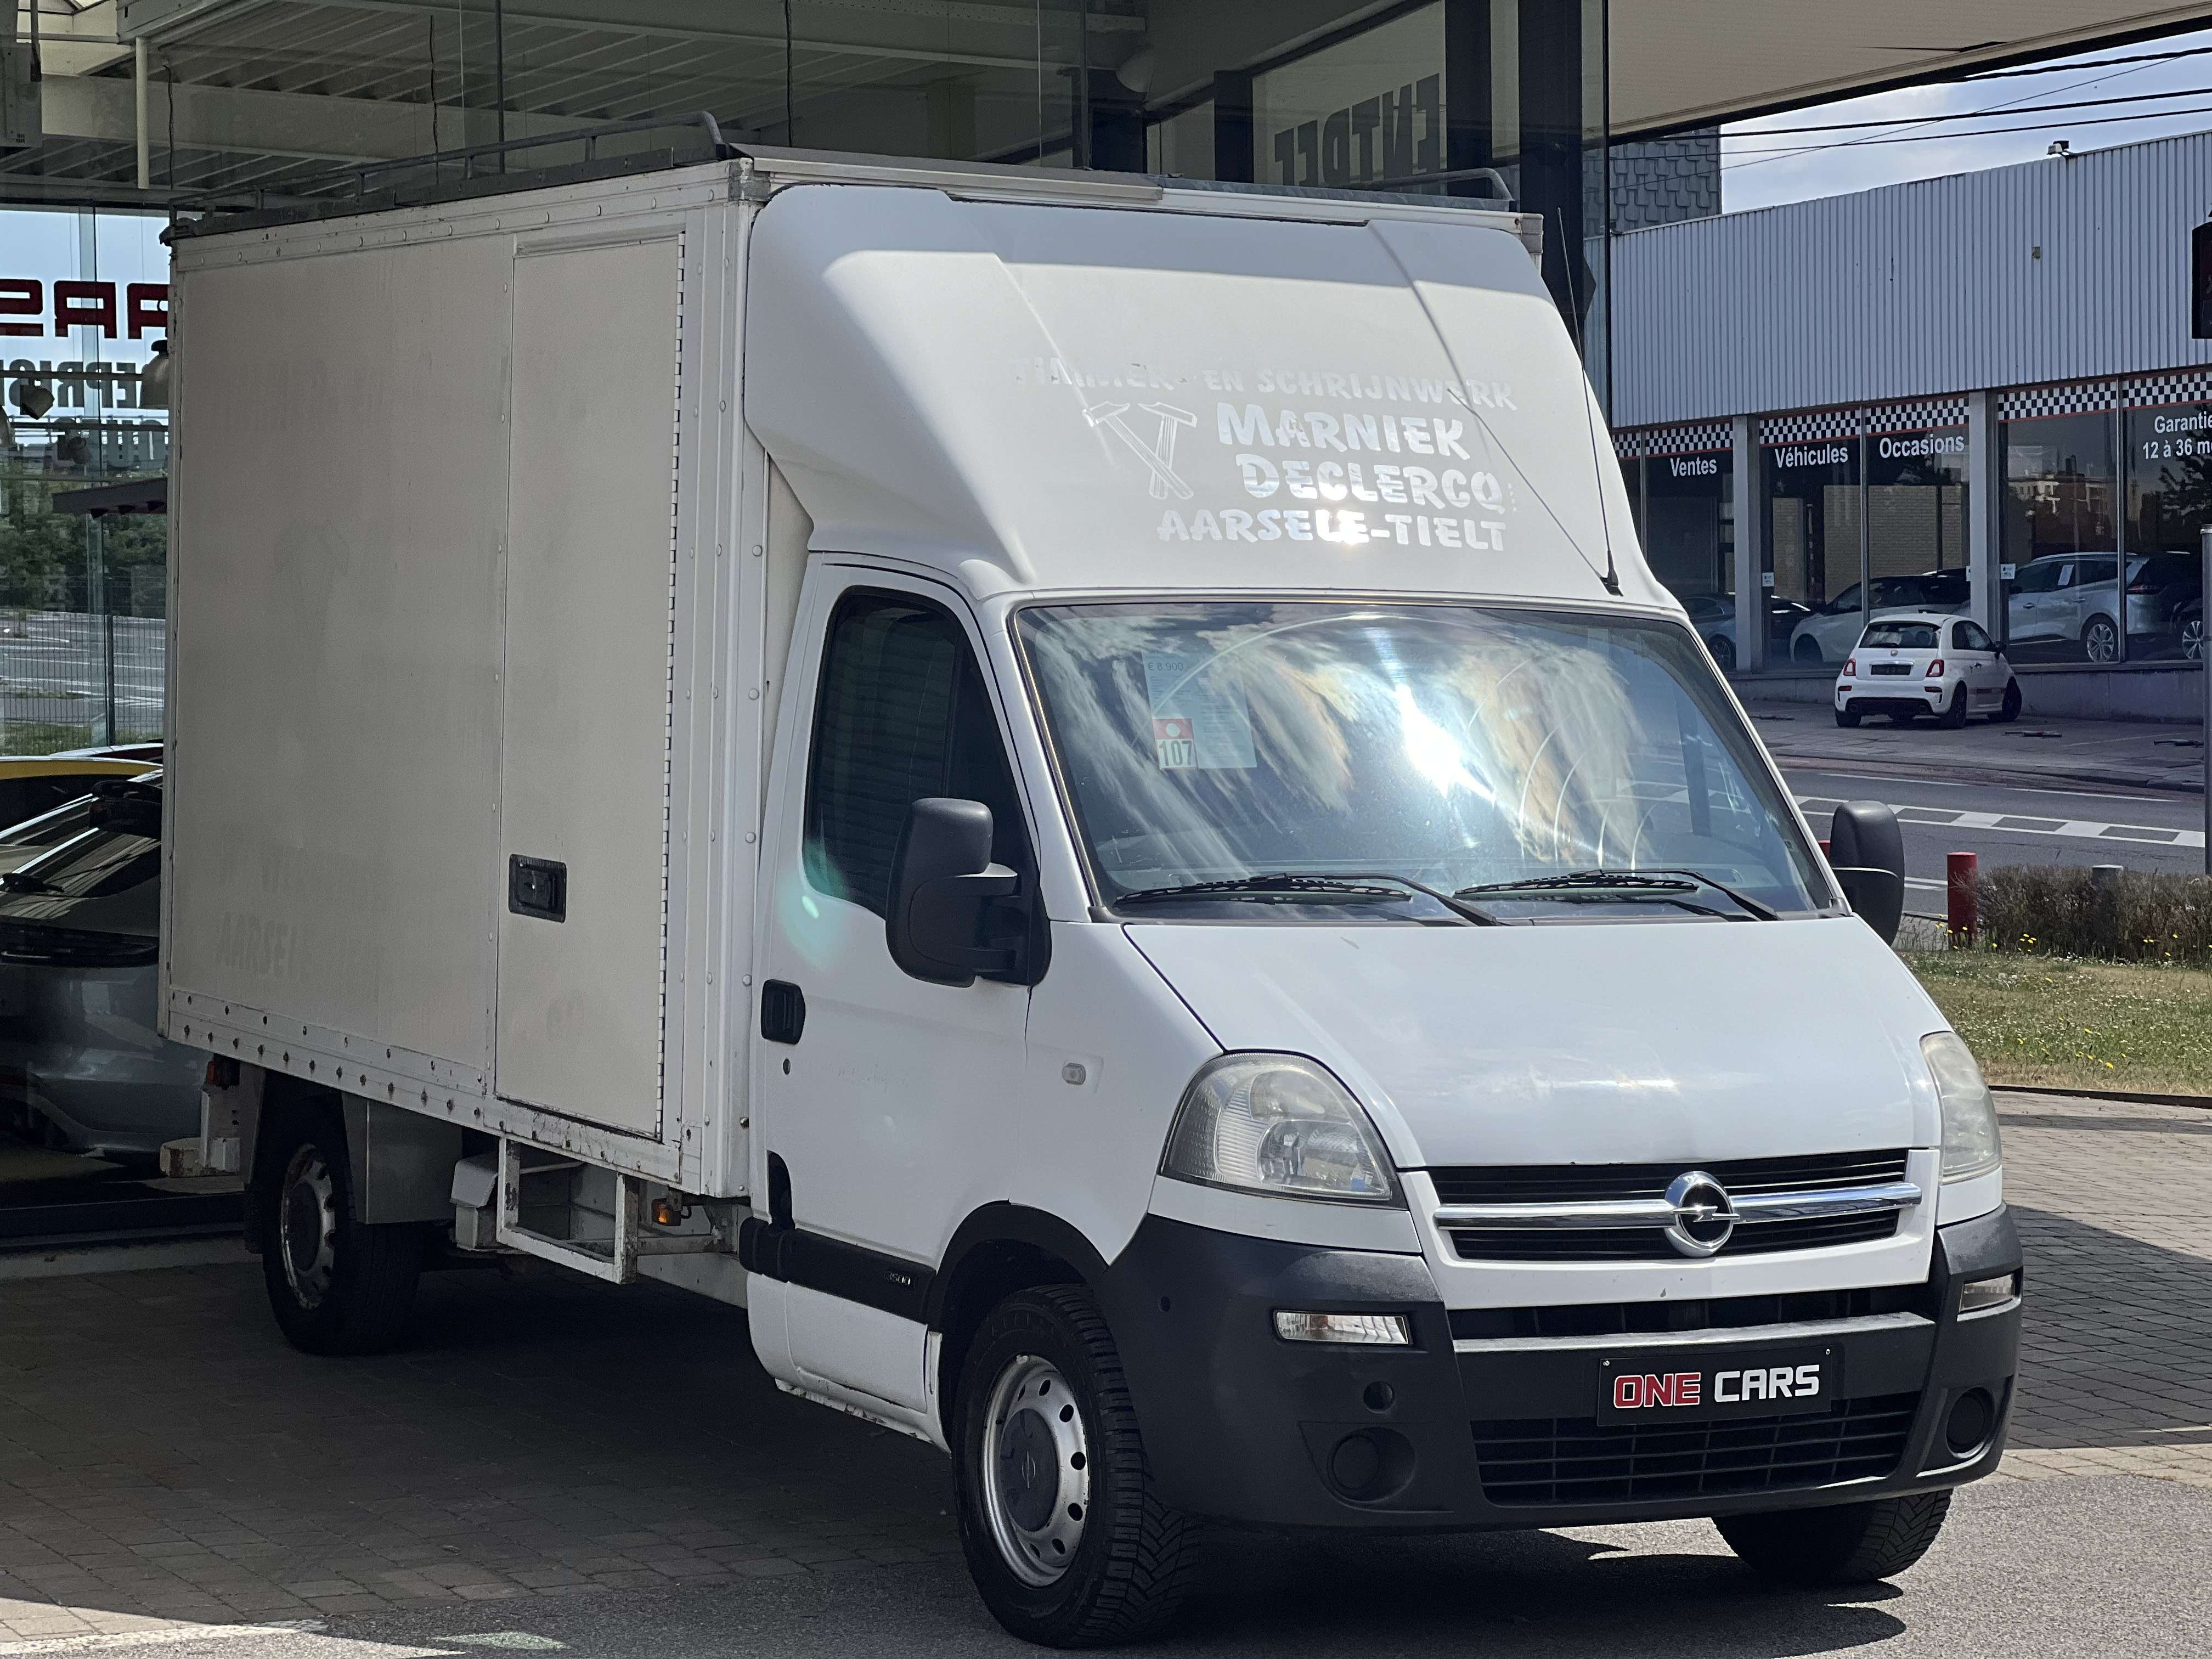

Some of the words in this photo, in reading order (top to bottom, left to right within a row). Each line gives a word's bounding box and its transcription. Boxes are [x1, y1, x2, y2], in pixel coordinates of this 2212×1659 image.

[1203, 370, 1244, 392] EN
[1217, 403, 1470, 461] MARNIEK
[1774, 444, 1848, 469] Véhicules
[1880, 433, 1965, 458] Occasions
[2143, 441, 2159, 459] 12
[2163, 439, 2171, 458] à
[2176, 438, 2192, 456] 36
[2197, 441, 2212, 455] m
[1670, 457, 1717, 477] Ventes
[1235, 454, 1506, 515] DECLERCQ
[1157, 508, 1506, 551] AARSELE-TIELT
[1159, 741, 1193, 766] 107
[1613, 1372, 1701, 1409] ONE
[1714, 1364, 1820, 1402] CARS
